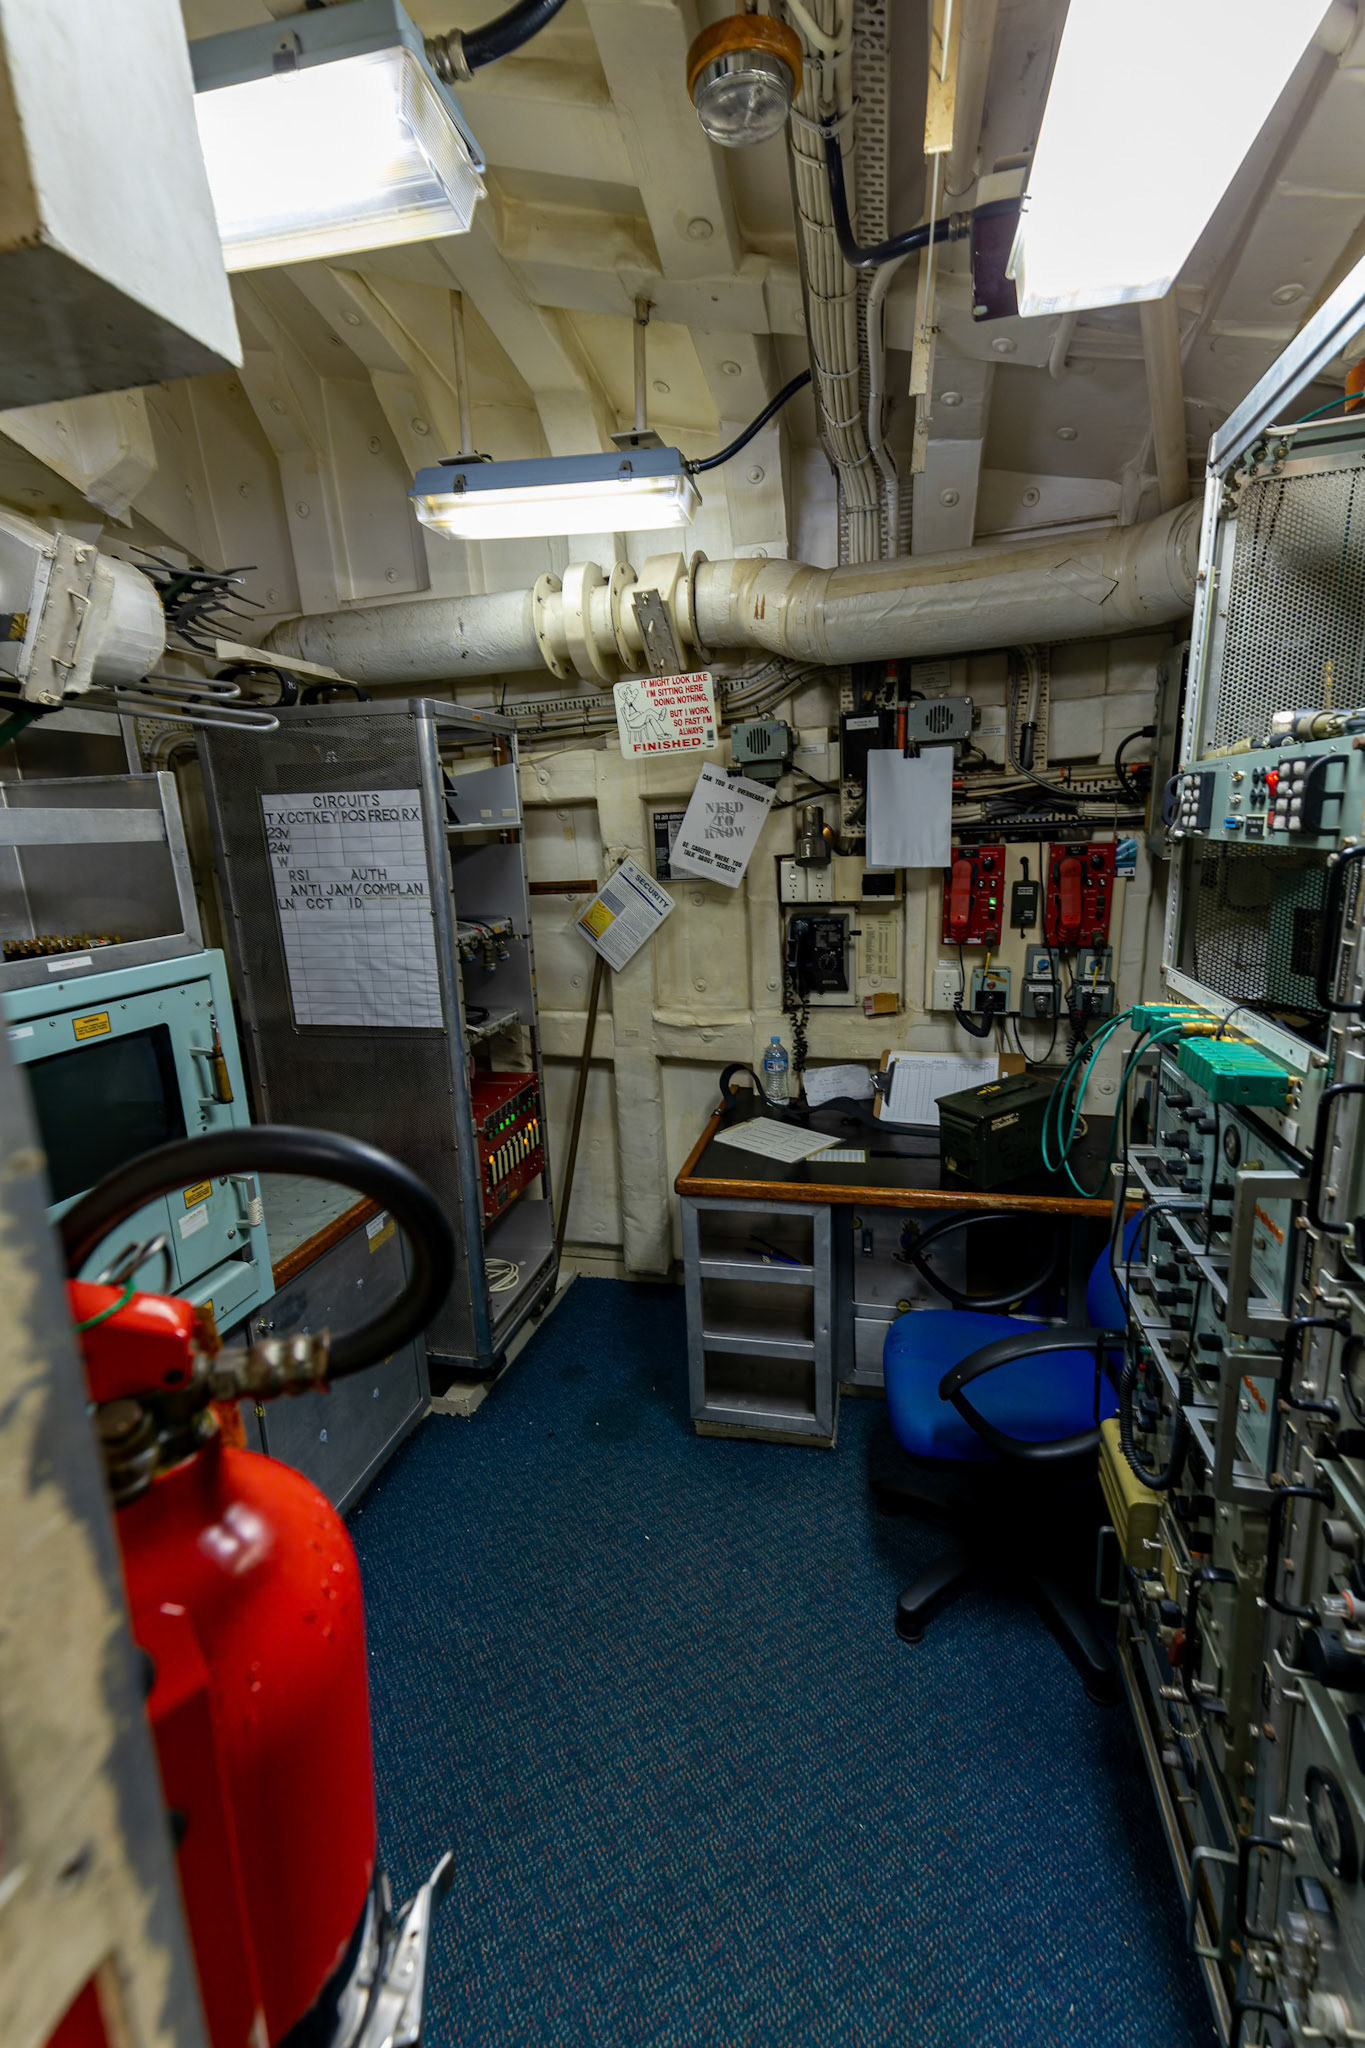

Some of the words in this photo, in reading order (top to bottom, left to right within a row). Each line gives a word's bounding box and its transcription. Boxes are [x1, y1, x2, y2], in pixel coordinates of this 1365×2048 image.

[641, 681, 647, 689] IT
[649, 678, 670, 687] MIGHT
[672, 676, 691, 685] LOOK
[692, 674, 708, 683] LIKE
[646, 690, 656, 698] I'M
[658, 687, 684, 697] SITTING
[685, 684, 704, 693] HERE
[654, 698, 676, 707] DOING
[677, 694, 709, 704] NOTHING,
[670, 709, 682, 718] BUT
[689, 706, 710, 715] WORK
[673, 719, 683, 727] SO
[685, 717, 701, 726] FAST
[679, 726, 704, 736] ALWAYS
[633, 737, 706, 753] FINISHED.
[702, 773, 712, 783] CAN
[715, 779, 725, 787] YOU
[728, 783, 735, 791] BE
[737, 787, 765, 803] OVERHEARD
[313, 794, 380, 808] CIRCUITS
[705, 802, 744, 814] NEED
[288, 811, 313, 824] CCT
[314, 811, 338, 824] KEY
[342, 810, 366, 822] POS
[369, 809, 399, 822] FREQ
[402, 808, 421, 821] RX
[717, 815, 735, 827] TO
[704, 826, 747, 839] KNOW
[682, 841, 689, 849] BE
[692, 844, 712, 857] CAREFUL
[714, 853, 730, 865] WHERE
[732, 860, 743, 868] YOU
[684, 849, 695, 859] TALK
[698, 854, 714, 865] ABOUT
[716, 861, 737, 873] SECRETS
[277, 856, 289, 867] W
[289, 869, 310, 881] RSI
[351, 868, 388, 881] AUTH
[291, 884, 322, 896] ANTI
[635, 874, 670, 909] SECURITY
[278, 899, 295, 910] LN
[307, 898, 333, 910] CCT
[350, 898, 363, 909] ID
